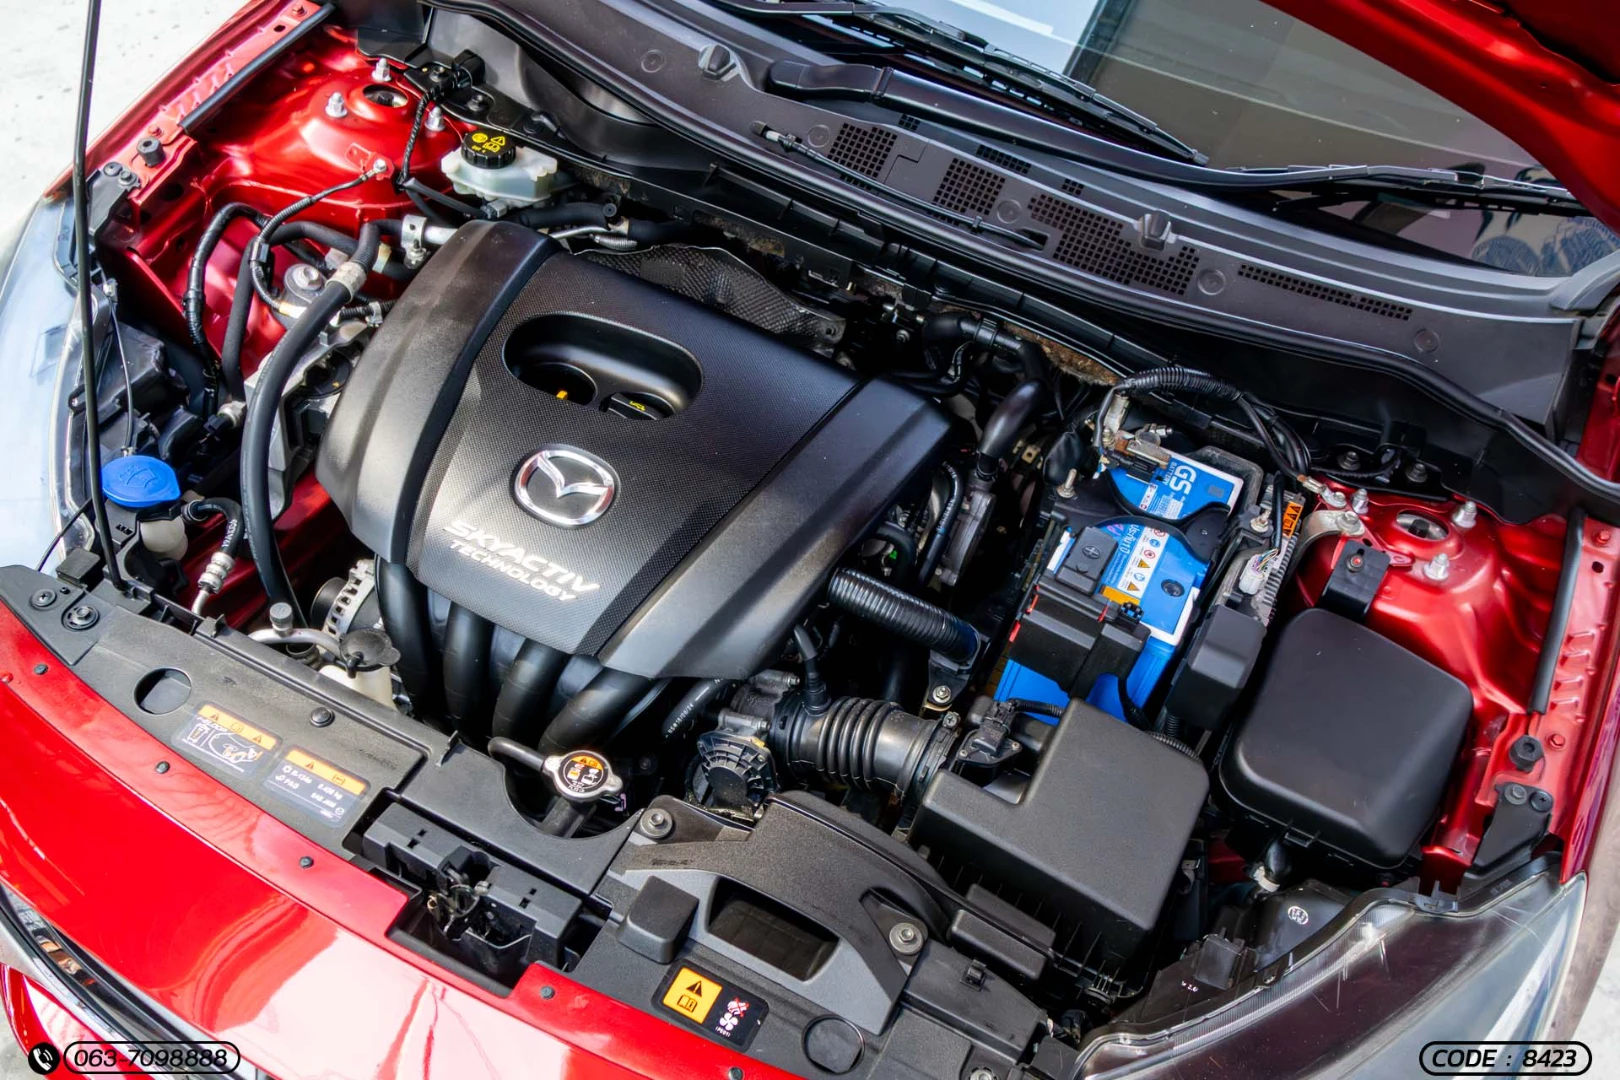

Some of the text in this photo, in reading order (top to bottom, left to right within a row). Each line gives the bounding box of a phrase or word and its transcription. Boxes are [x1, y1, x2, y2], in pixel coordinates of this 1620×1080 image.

[1162, 461, 1178, 486] BATTERY
[1169, 465, 1197, 495] GS
[444, 520, 600, 593] SKYACTIV
[450, 539, 577, 601] TECHNOLOGY
